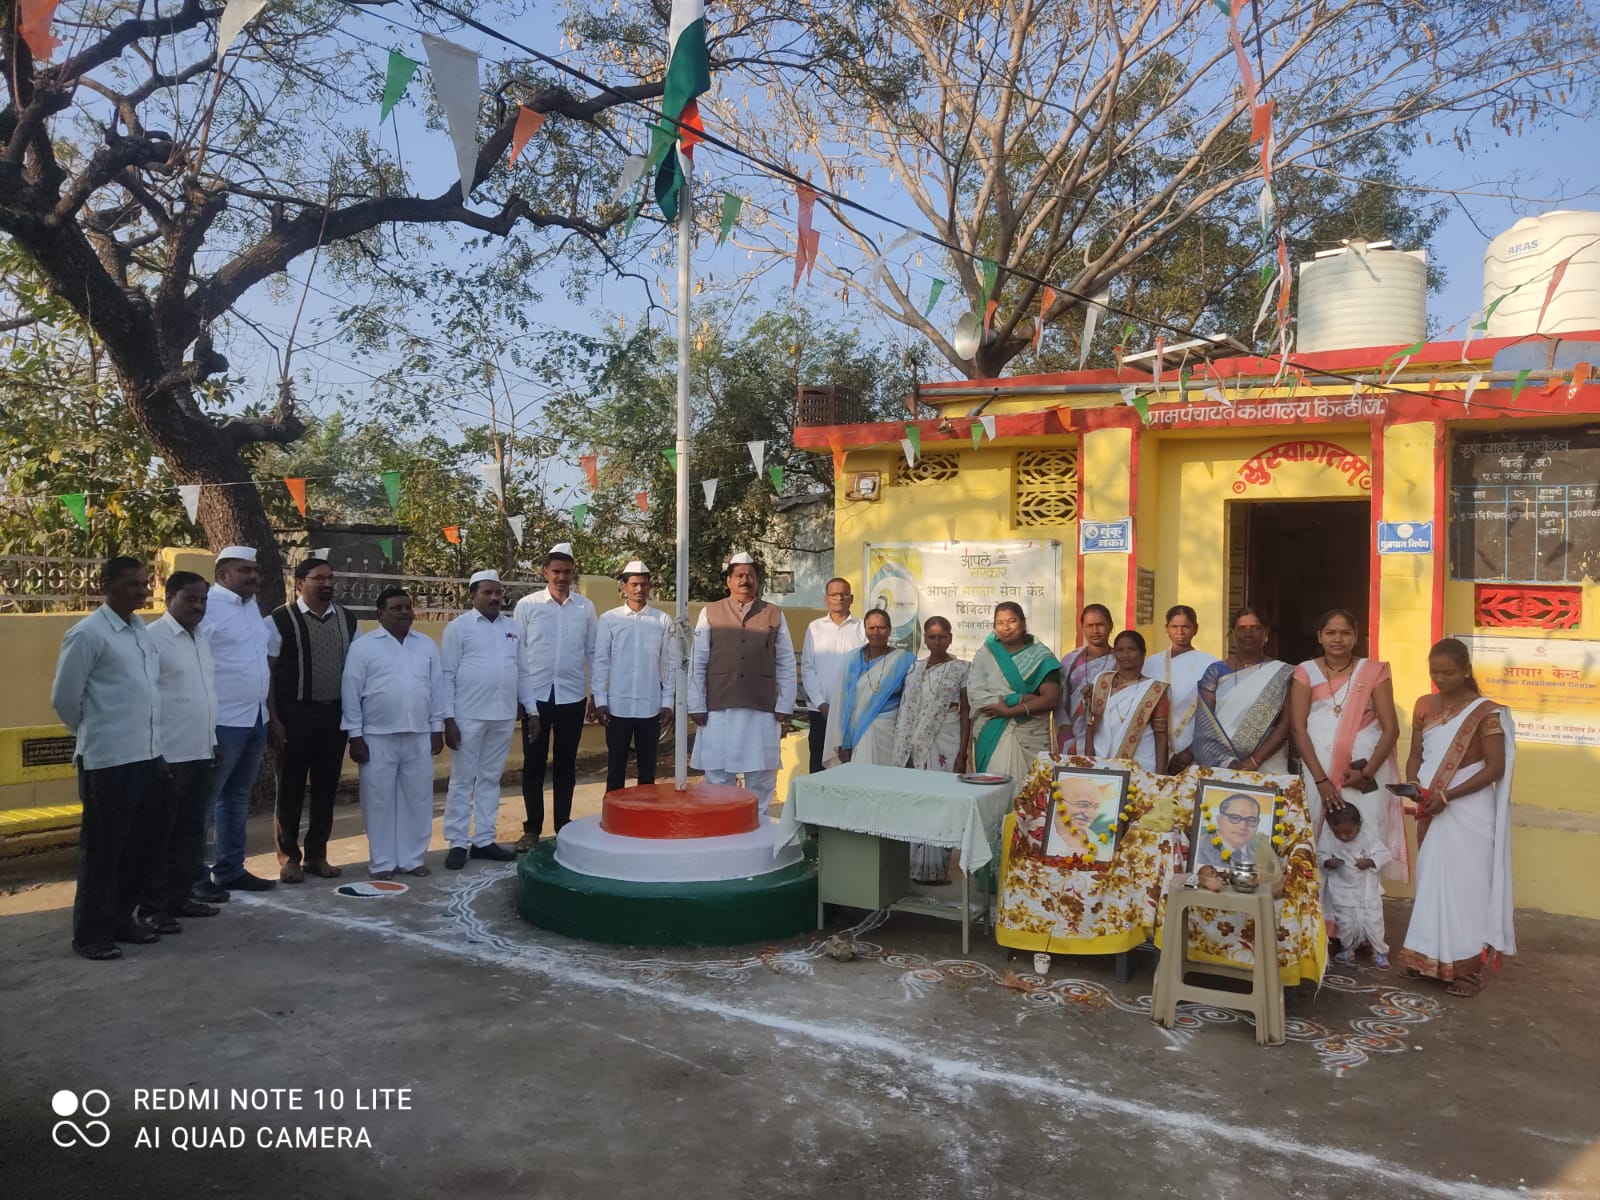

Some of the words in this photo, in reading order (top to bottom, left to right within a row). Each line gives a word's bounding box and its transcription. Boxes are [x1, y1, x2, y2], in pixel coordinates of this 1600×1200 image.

[960, 552, 992, 569] आपले
[969, 567, 1007, 579] सरकार
[927, 583, 958, 598] आपले
[999, 583, 1021, 597] सेवा
